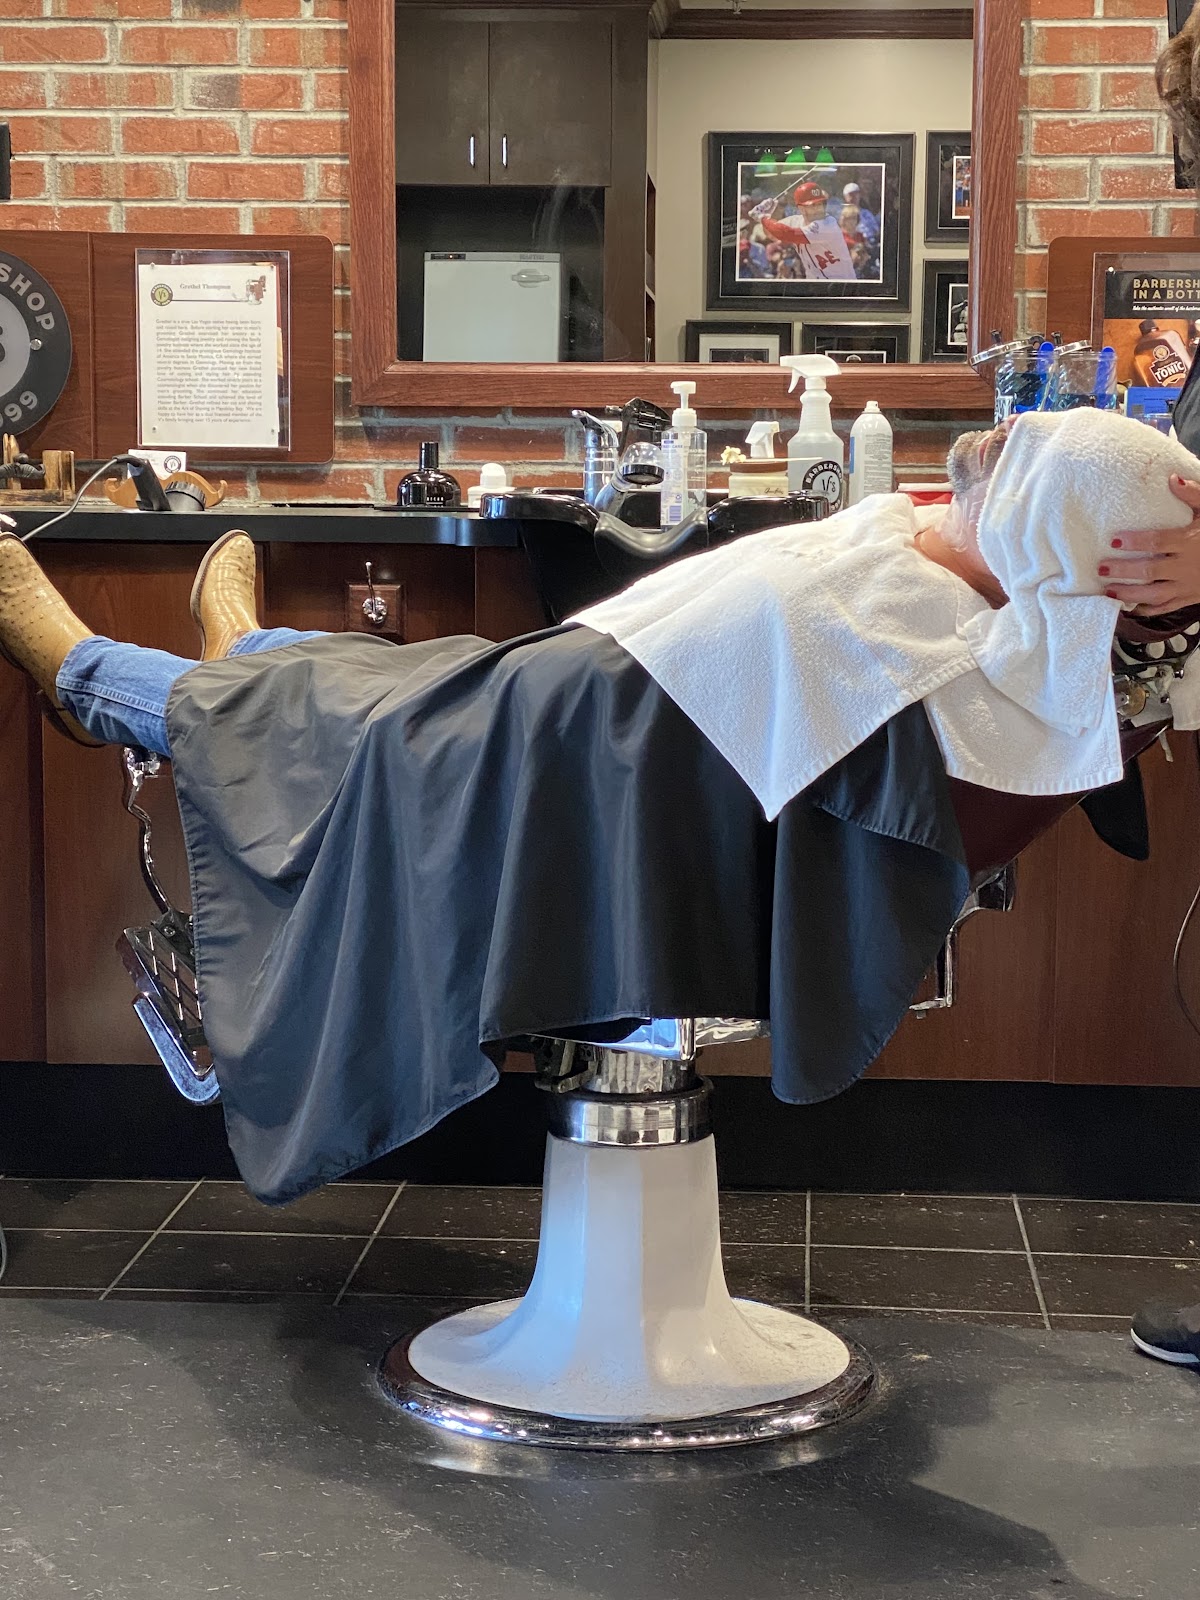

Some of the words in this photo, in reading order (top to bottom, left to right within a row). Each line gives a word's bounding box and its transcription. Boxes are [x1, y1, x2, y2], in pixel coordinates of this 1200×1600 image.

[1133, 278, 1200, 288] BARBERSH
[1133, 289, 1148, 299] IN
[1152, 289, 1162, 299] A
[1166, 289, 1200, 299] BOTT
[1154, 362, 1184, 380] TONIC
